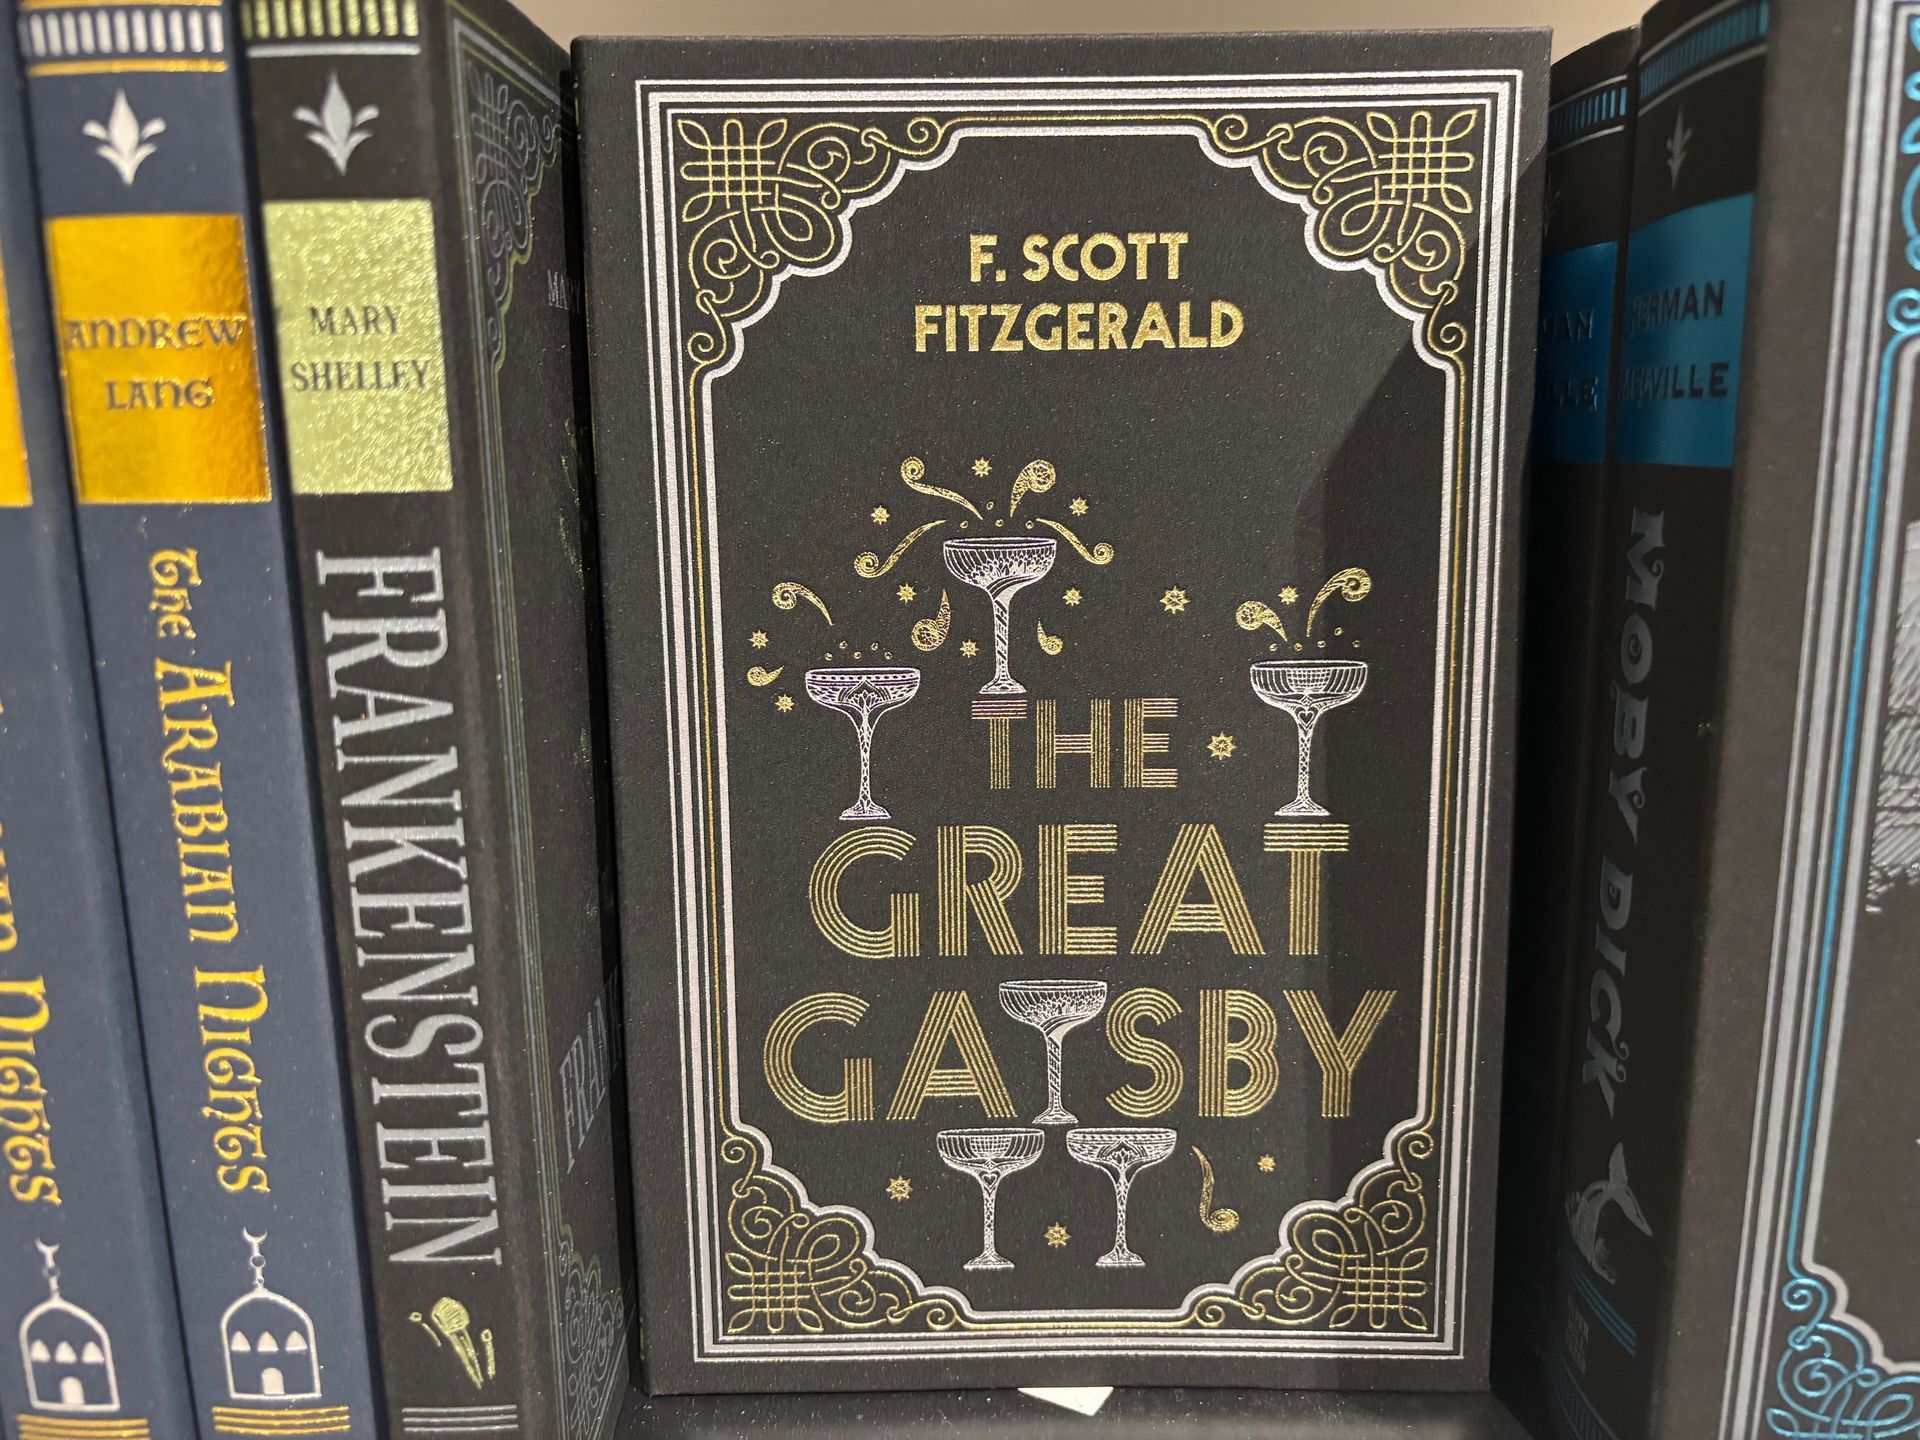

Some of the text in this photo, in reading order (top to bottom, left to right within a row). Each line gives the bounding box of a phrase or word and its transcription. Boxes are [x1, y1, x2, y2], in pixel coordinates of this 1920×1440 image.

[970, 232, 1189, 282] F. SCOTT
[64, 314, 247, 350] ANDREW
[310, 306, 400, 336] MARY
[915, 301, 1244, 352] FITZGERALD
[105, 378, 214, 409] LANG
[290, 358, 431, 393] SHELLEY
[971, 698, 1178, 789] THE
[1581, 506, 1666, 1119] MOBY DICK
[316, 547, 501, 1266] FRANKENSTEIN
[808, 823, 1350, 959] GREAT
[763, 979, 1397, 1123] GATSBY
